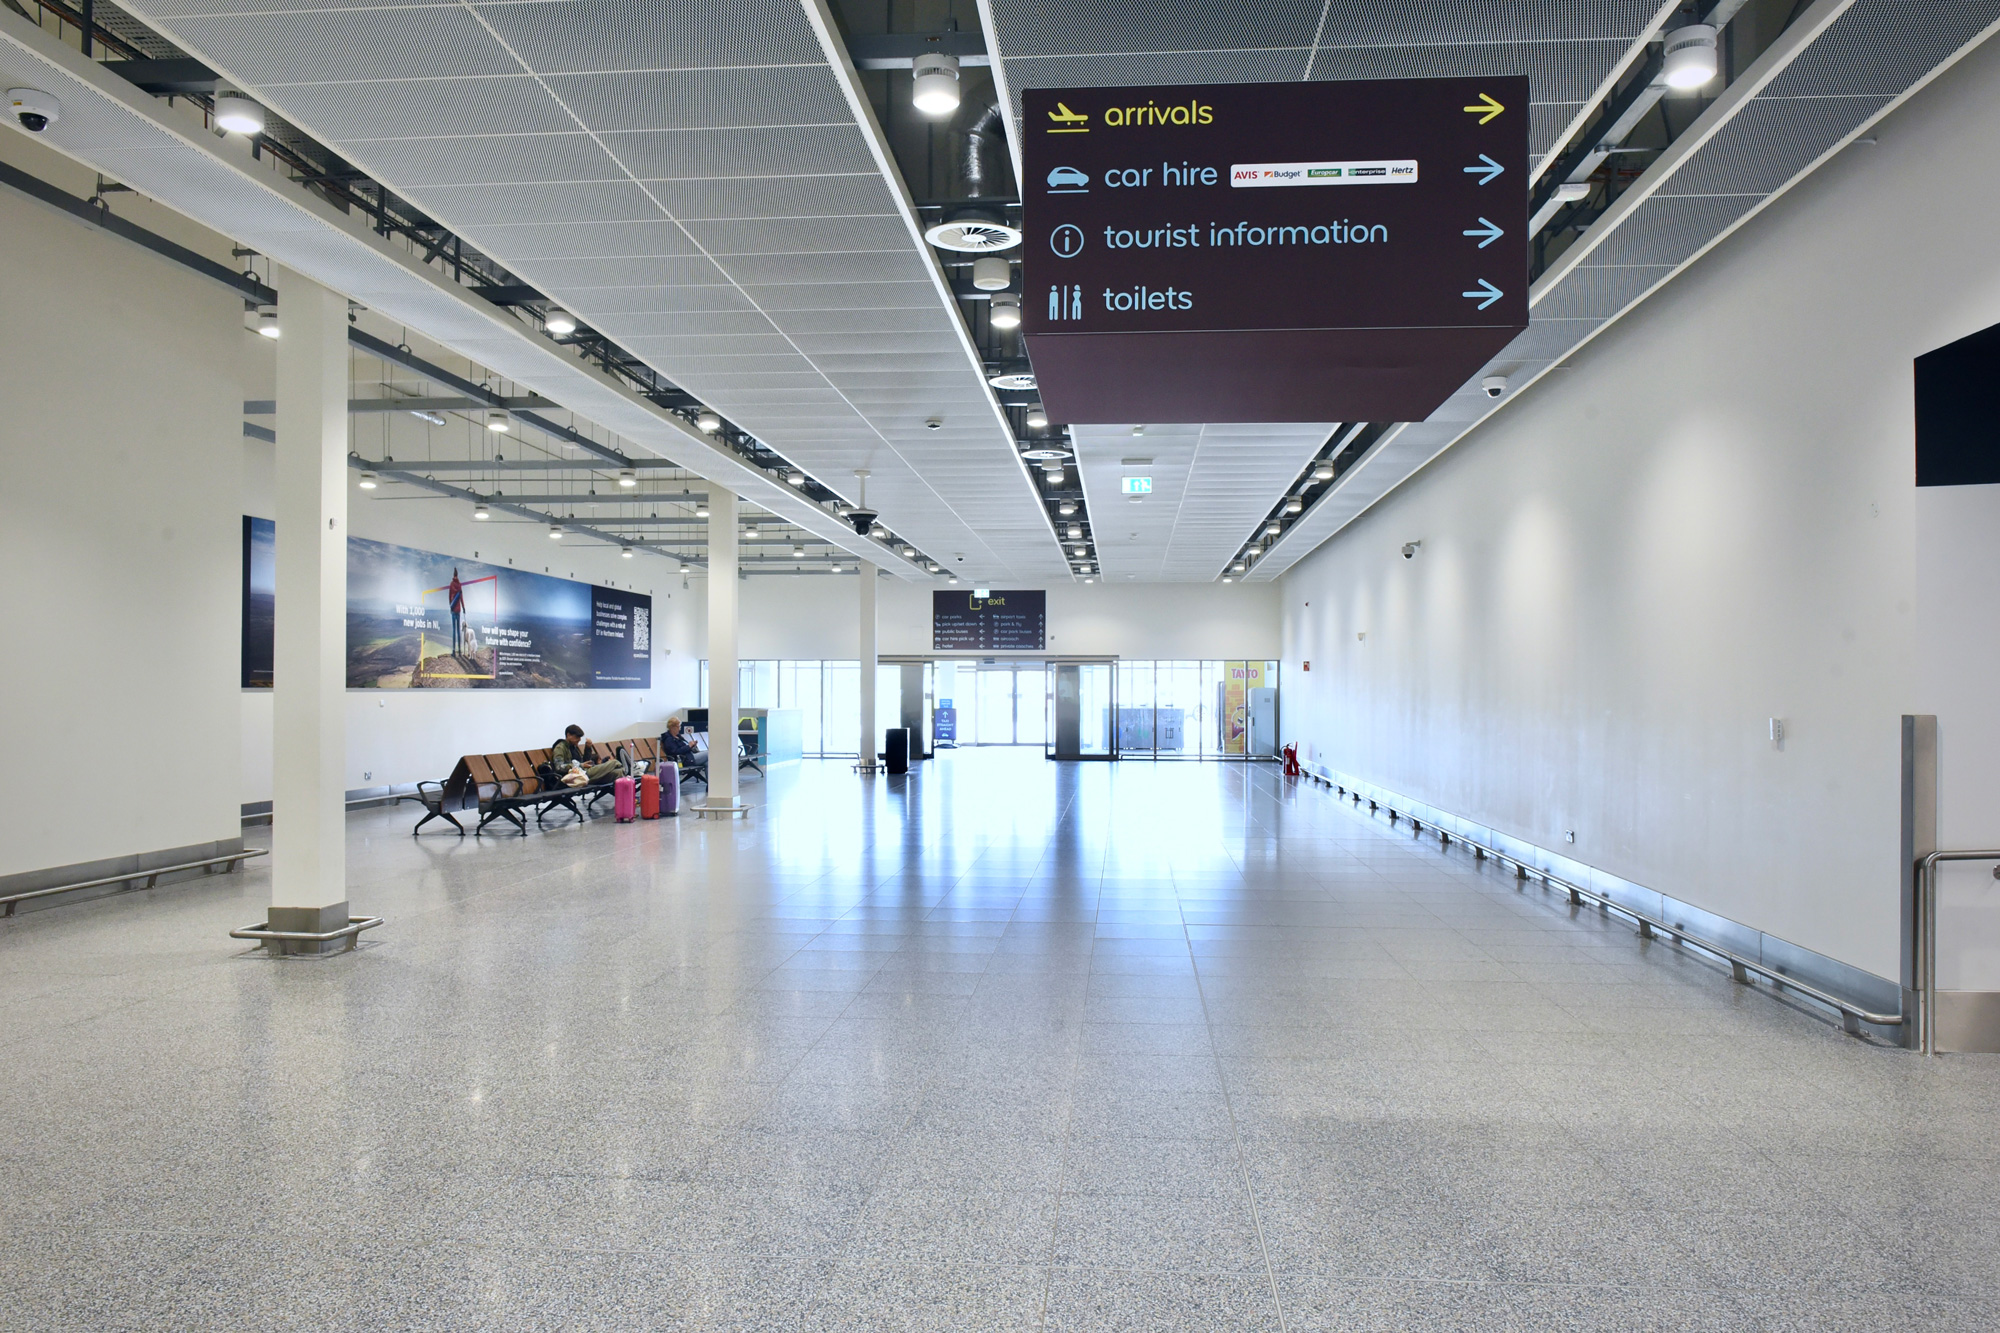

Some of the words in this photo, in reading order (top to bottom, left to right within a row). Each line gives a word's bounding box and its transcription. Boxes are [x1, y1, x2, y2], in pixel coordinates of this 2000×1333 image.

[1105, 100, 1213, 125] arrivals
[1105, 169, 1153, 187] car
[1163, 162, 1217, 186] hire
[1234, 171, 1258, 180] AVIS
[1274, 171, 1300, 180] Budget
[1310, 169, 1338, 177] Europcar
[1104, 223, 1199, 248] tourist
[1211, 219, 1388, 246] information
[1103, 286, 1193, 310] toilets
[988, 596, 1006, 606] exit
[396, 603, 408, 615] With
[409, 605, 425, 617] 1,000
[403, 619, 415, 627] new
[414, 618, 426, 629] jobs
[426, 619, 432, 629] in
[432, 620, 440, 631] NI,
[481, 625, 490, 634] how
[499, 628, 507, 637] you
[507, 628, 519, 638] shape
[520, 631, 529, 639] your
[485, 636, 499, 646] future
[500, 638, 508, 646] with
[509, 639, 532, 648] confidence?
